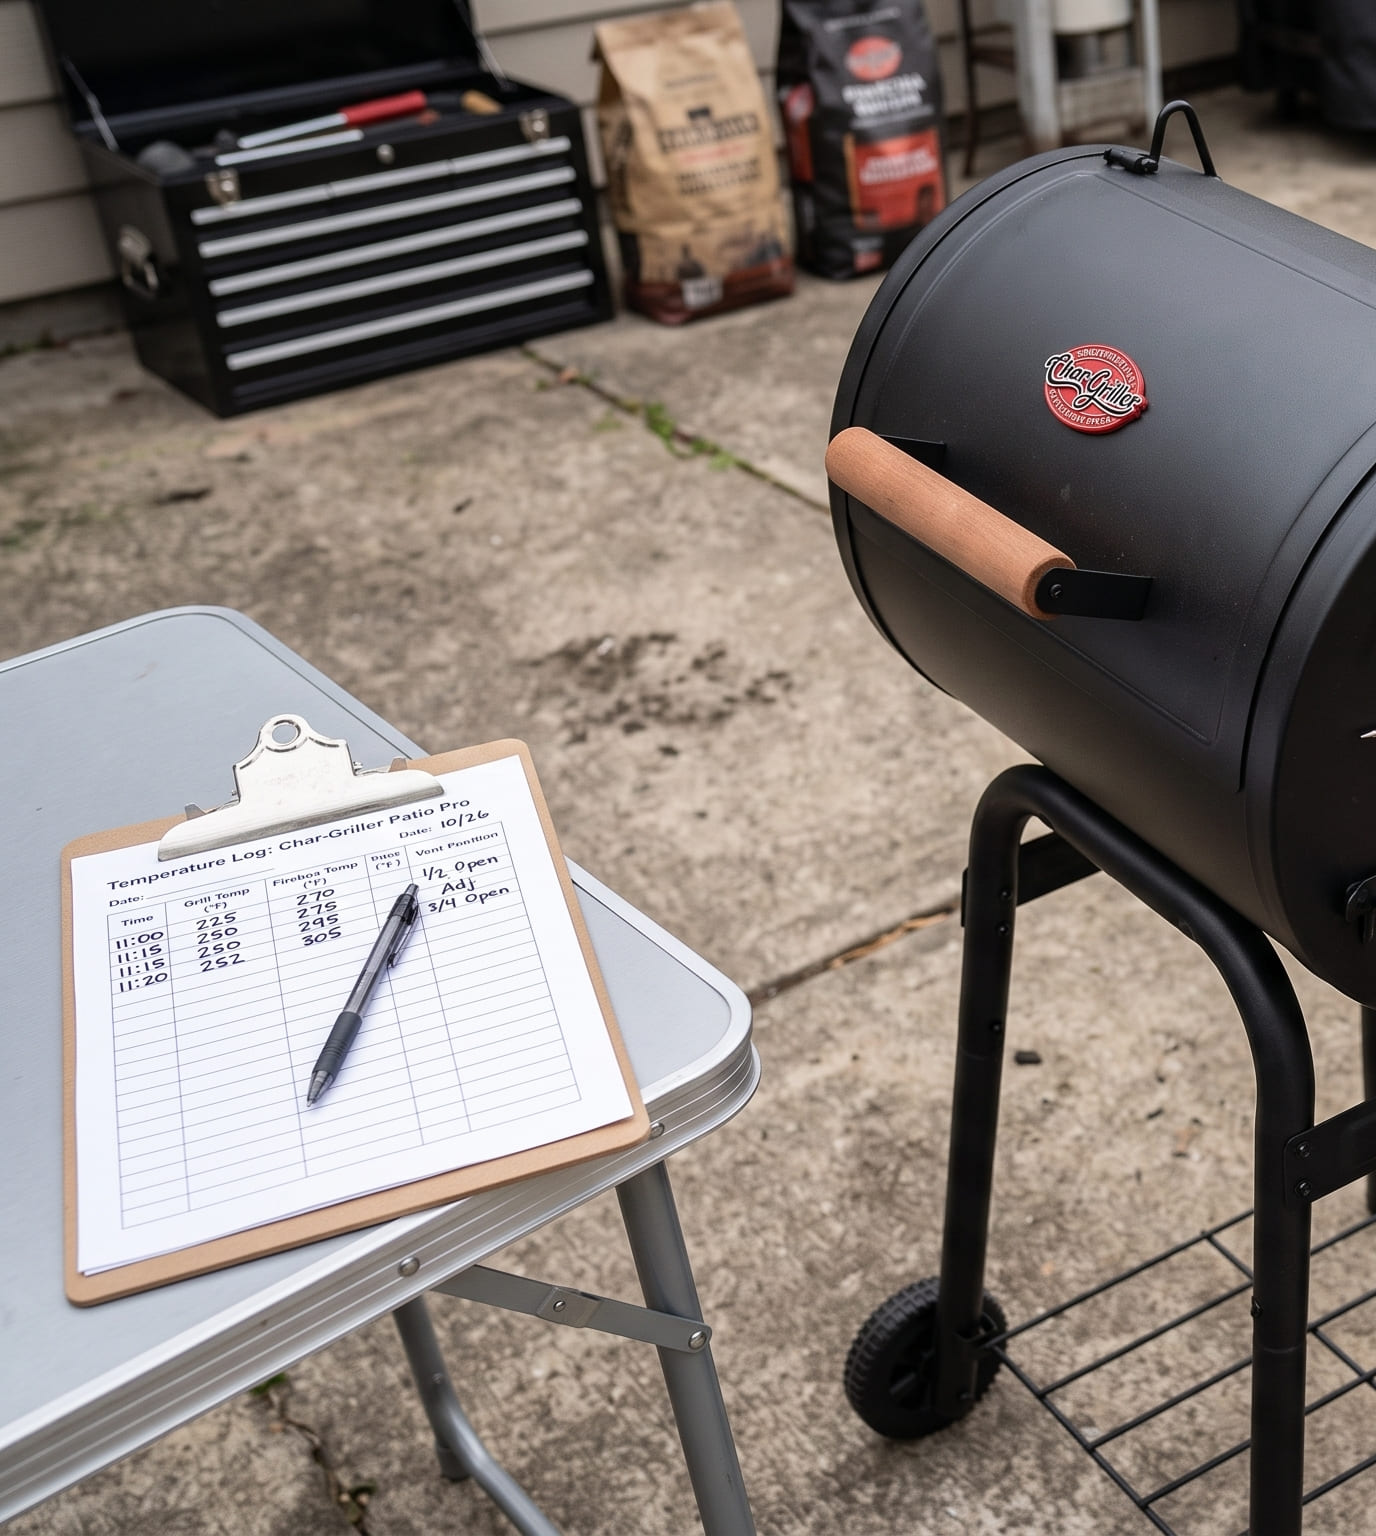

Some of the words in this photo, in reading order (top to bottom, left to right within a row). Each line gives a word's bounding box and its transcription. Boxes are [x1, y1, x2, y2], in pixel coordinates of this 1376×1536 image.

[399, 827, 432, 838] Date:
[441, 810, 489, 828] 10/26
[106, 859, 226, 890] Temperature
[232, 847, 273, 862] Log:
[279, 820, 384, 851] Char-Griller
[389, 809, 434, 824] Patio
[440, 800, 470, 811] Pro
[423, 866, 448, 881] 1/2
[455, 856, 499, 872] Open
[109, 894, 144, 907] Date:
[296, 888, 335, 906] 270
[428, 897, 456, 912] 3/4
[465, 887, 509, 905] Open
[297, 900, 338, 919] 275
[196, 912, 237, 930] 225
[298, 913, 339, 933] 295
[116, 931, 164, 950] 11:00
[197, 927, 238, 944] 250
[301, 926, 343, 946] 305
[118, 944, 162, 963] 11:15
[197, 941, 241, 959] 250
[120, 958, 165, 978] 11:15
[200, 953, 245, 972] 252
[120, 973, 168, 993] 11:20
